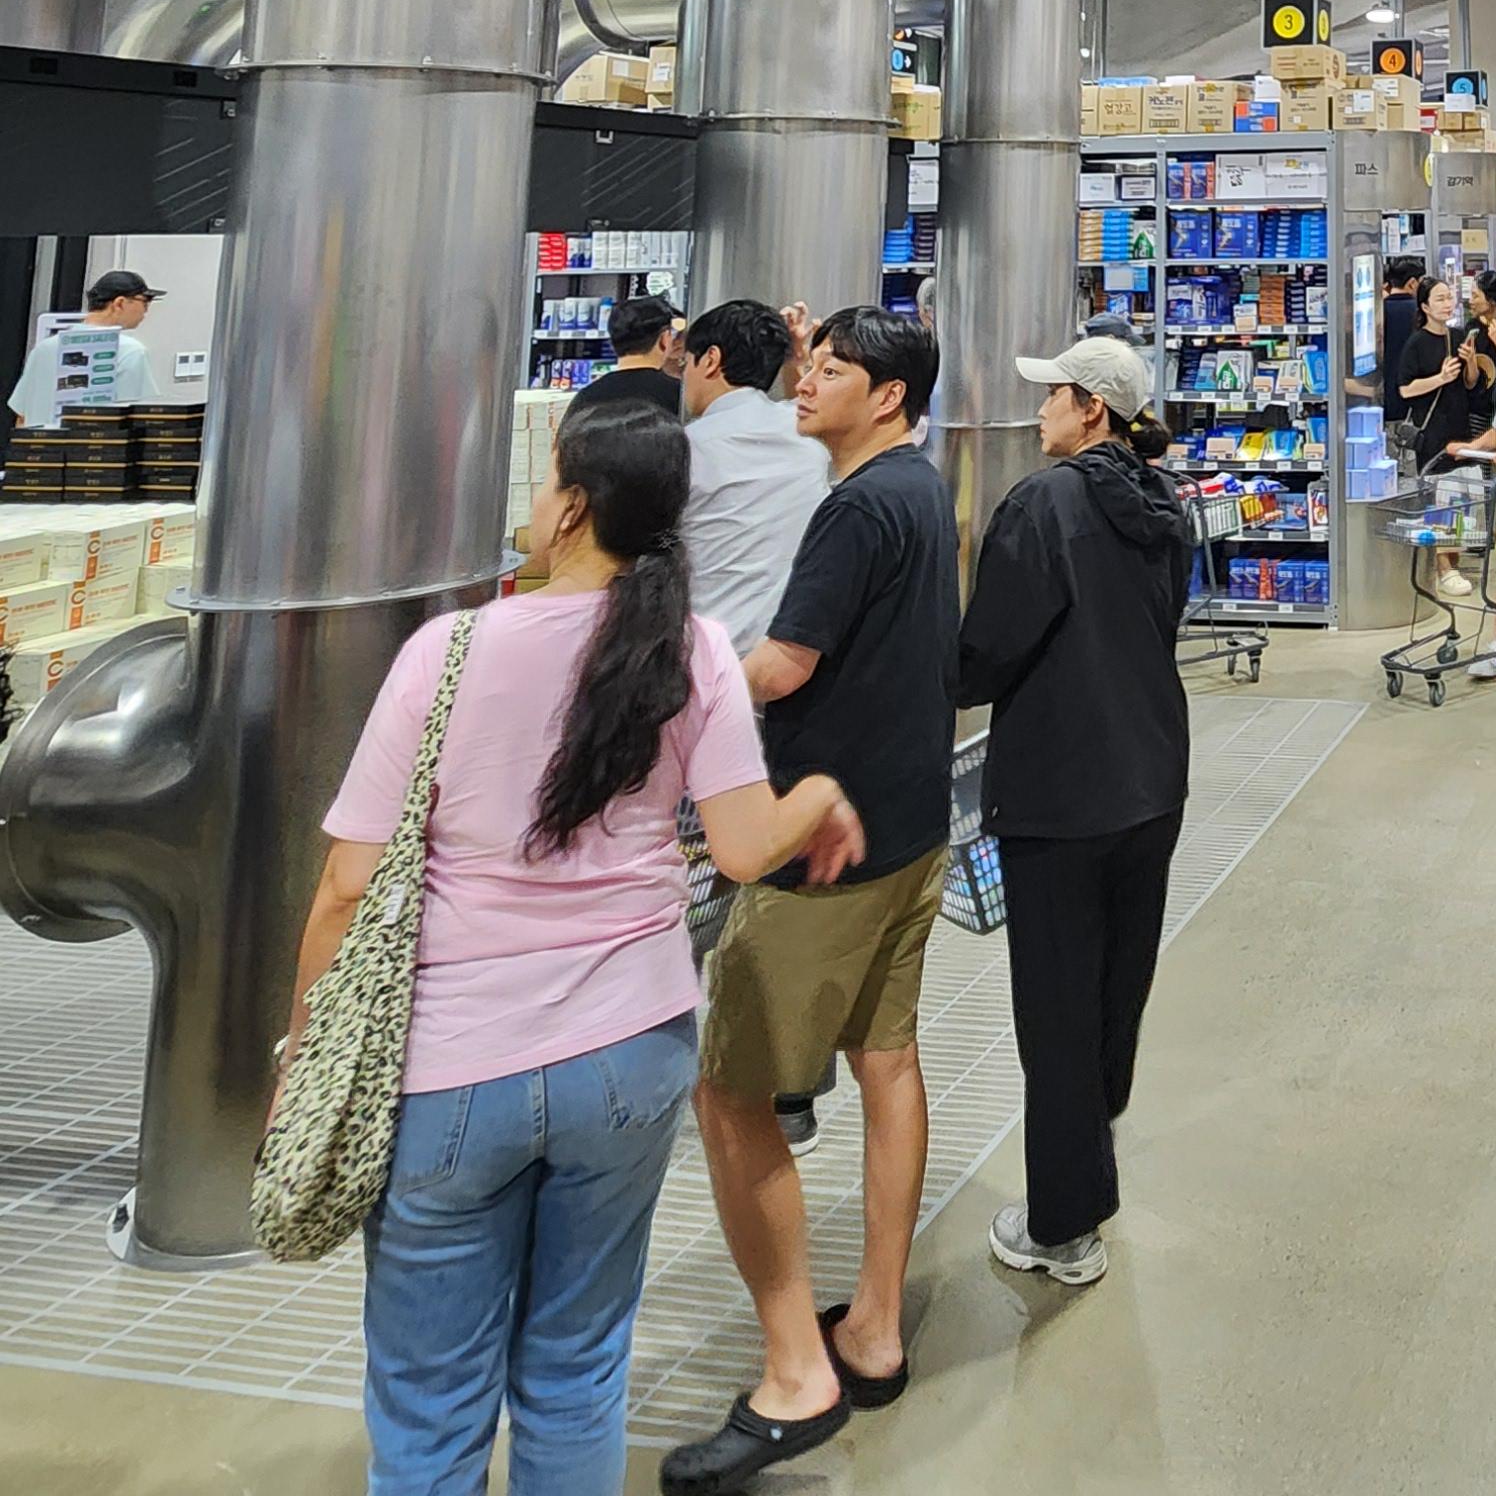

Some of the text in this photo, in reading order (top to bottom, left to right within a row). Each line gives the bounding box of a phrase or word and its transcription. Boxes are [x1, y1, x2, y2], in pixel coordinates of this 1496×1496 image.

[1284, 14, 1293, 30] 3
[1389, 54, 1397, 68] 4
[1459, 83, 1466, 94] 5
[1355, 162, 1379, 175] 파스
[1447, 175, 1473, 186] 감기약
